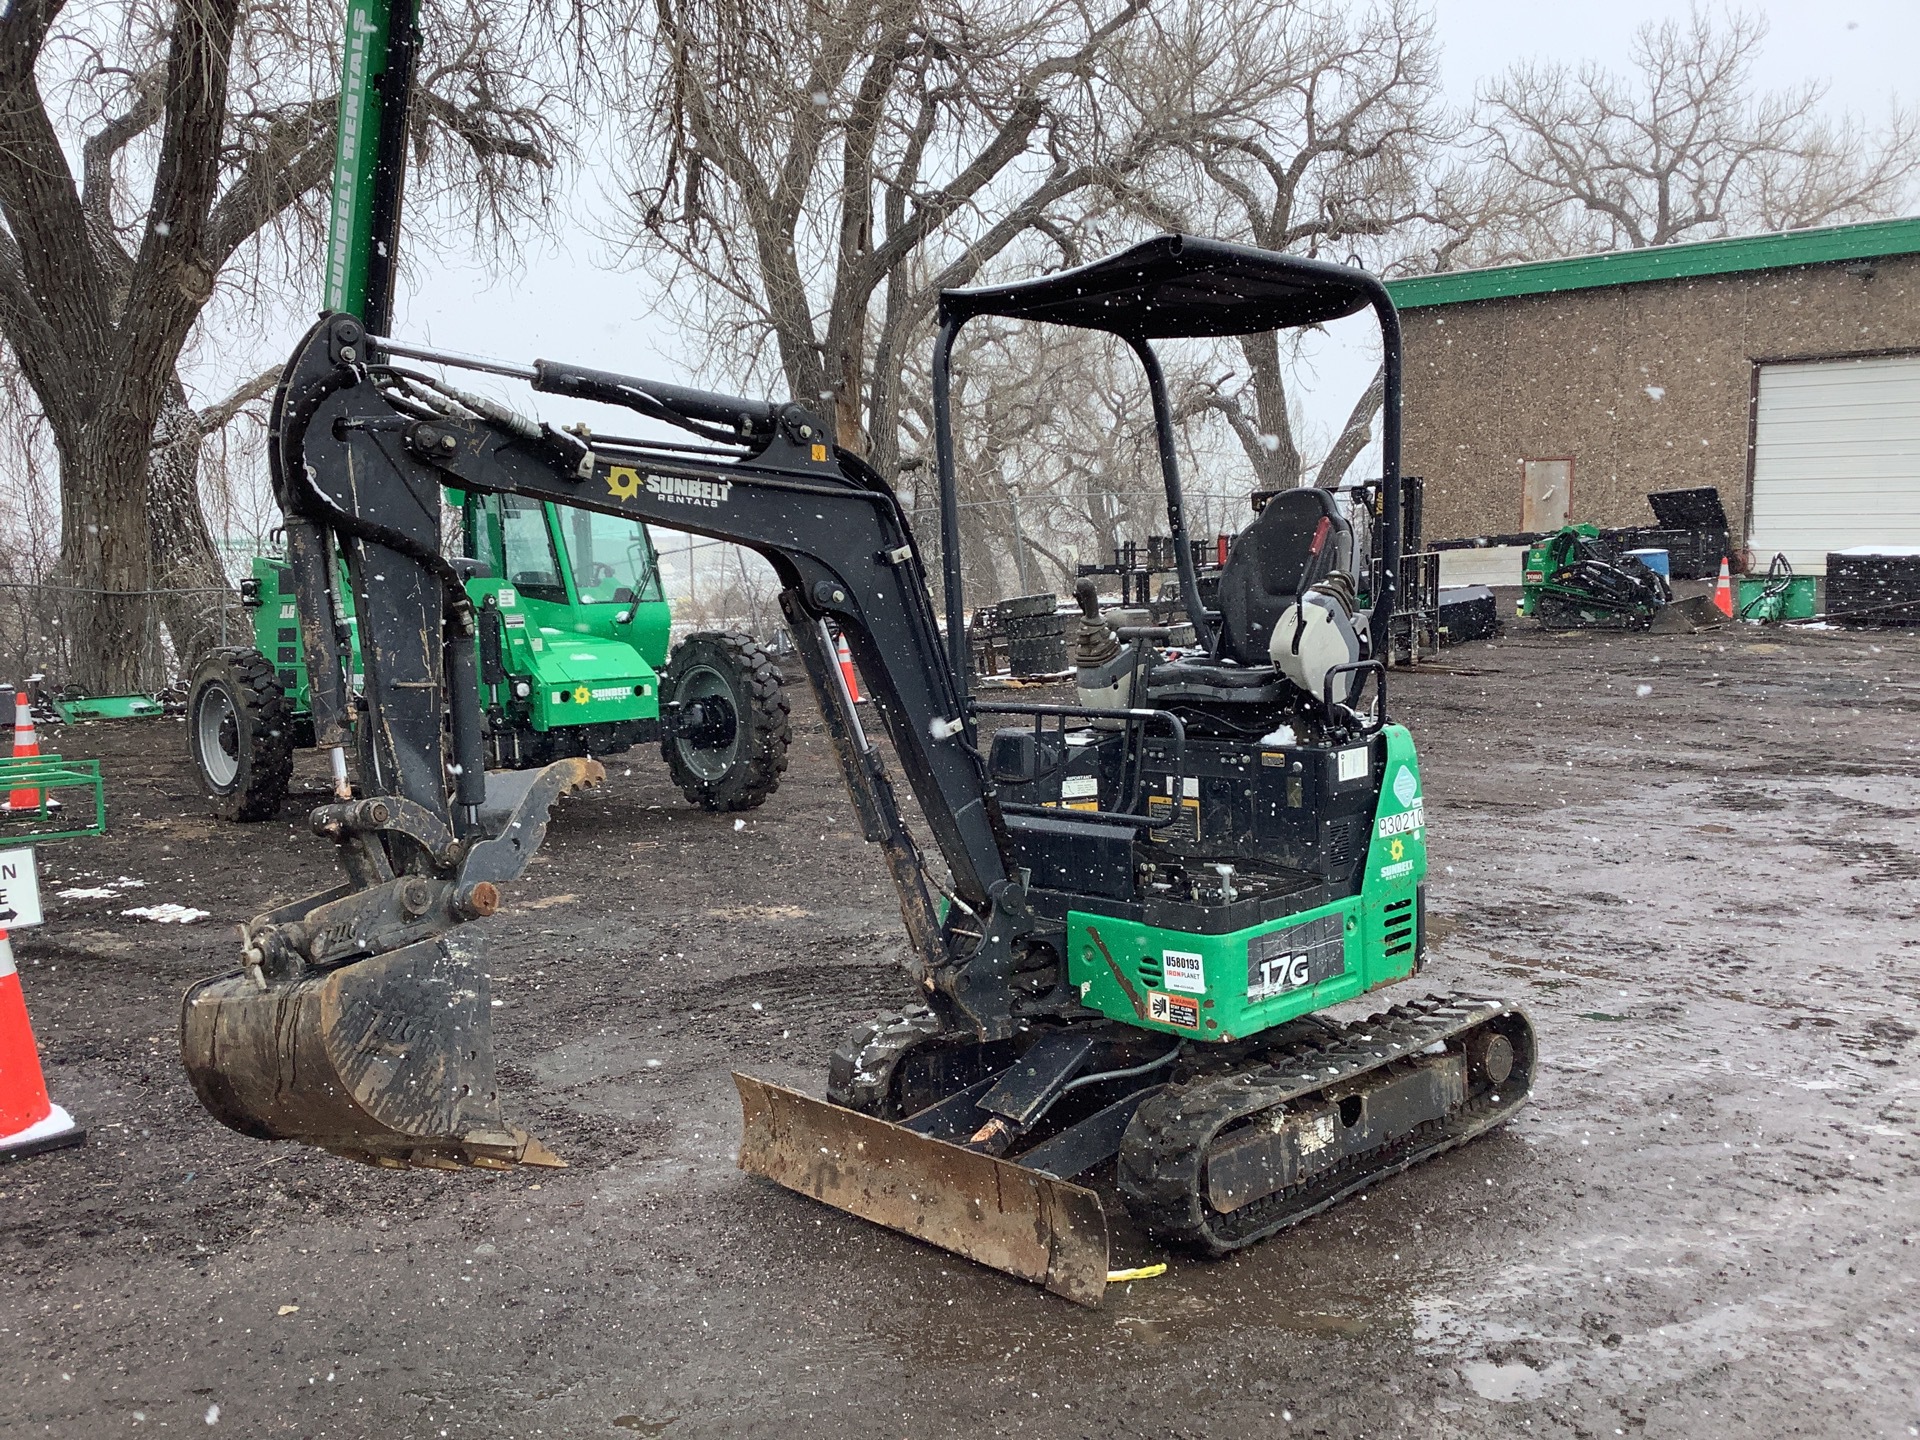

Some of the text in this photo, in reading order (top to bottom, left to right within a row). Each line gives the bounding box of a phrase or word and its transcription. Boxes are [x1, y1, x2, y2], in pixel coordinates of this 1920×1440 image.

[330, 8, 365, 309] SUNBELT RENTALS
[646, 475, 728, 501] SUNBELT
[658, 494, 718, 507] RENTALS
[280, 604, 295, 618] JLG
[591, 686, 632, 698] SUNBELT
[1380, 808, 1423, 835] 930210
[1381, 860, 1414, 878] SUNBELT
[1385, 871, 1409, 880] RENTALS
[1165, 956, 1200, 970] U580193
[1166, 969, 1200, 980] IRONPLANET
[1260, 954, 1309, 995] 17G
